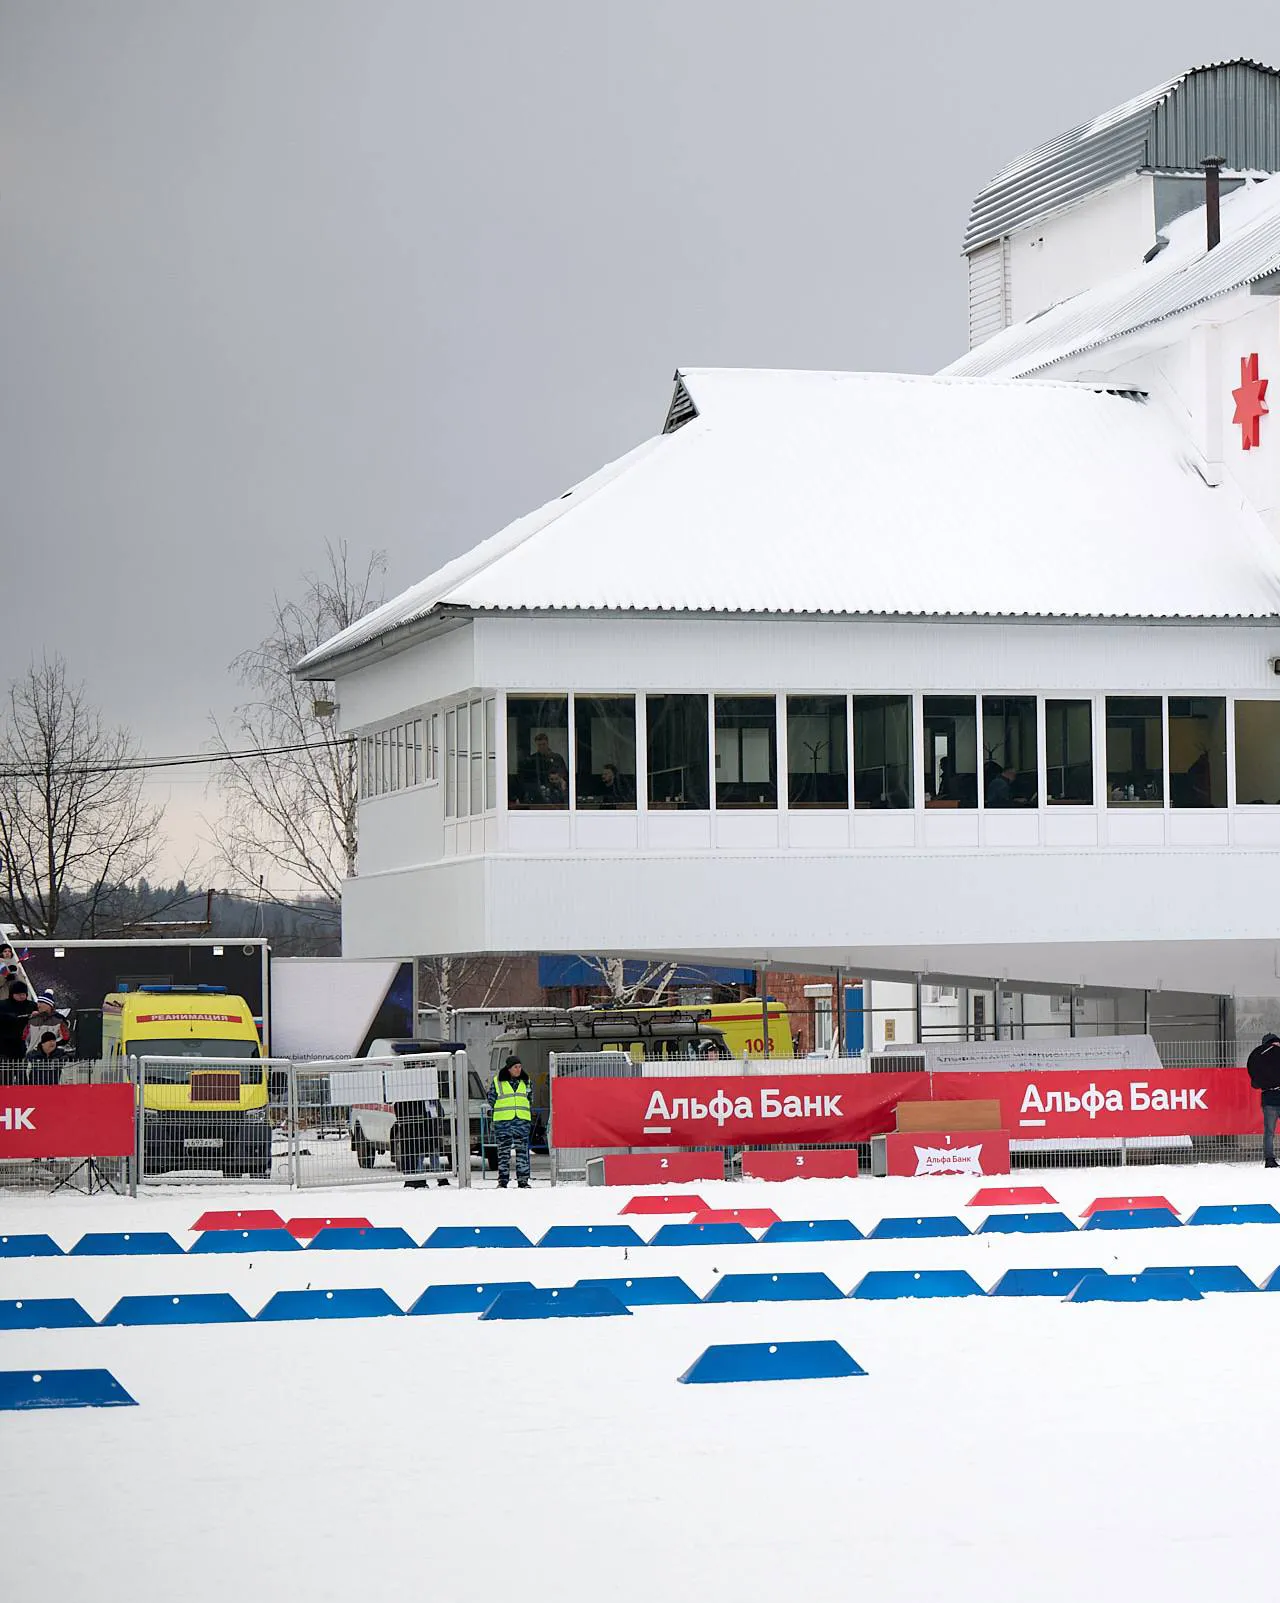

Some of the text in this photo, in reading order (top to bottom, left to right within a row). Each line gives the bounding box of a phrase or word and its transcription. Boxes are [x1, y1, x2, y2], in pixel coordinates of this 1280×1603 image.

[1019, 1081, 1209, 1119] Альфа Банк
[643, 1088, 845, 1127] Альфа Банк
[944, 1135, 951, 1145] 1
[660, 1158, 669, 1168] 2
[796, 1156, 804, 1166] 3
[926, 1155, 972, 1165] Альфа Банк
